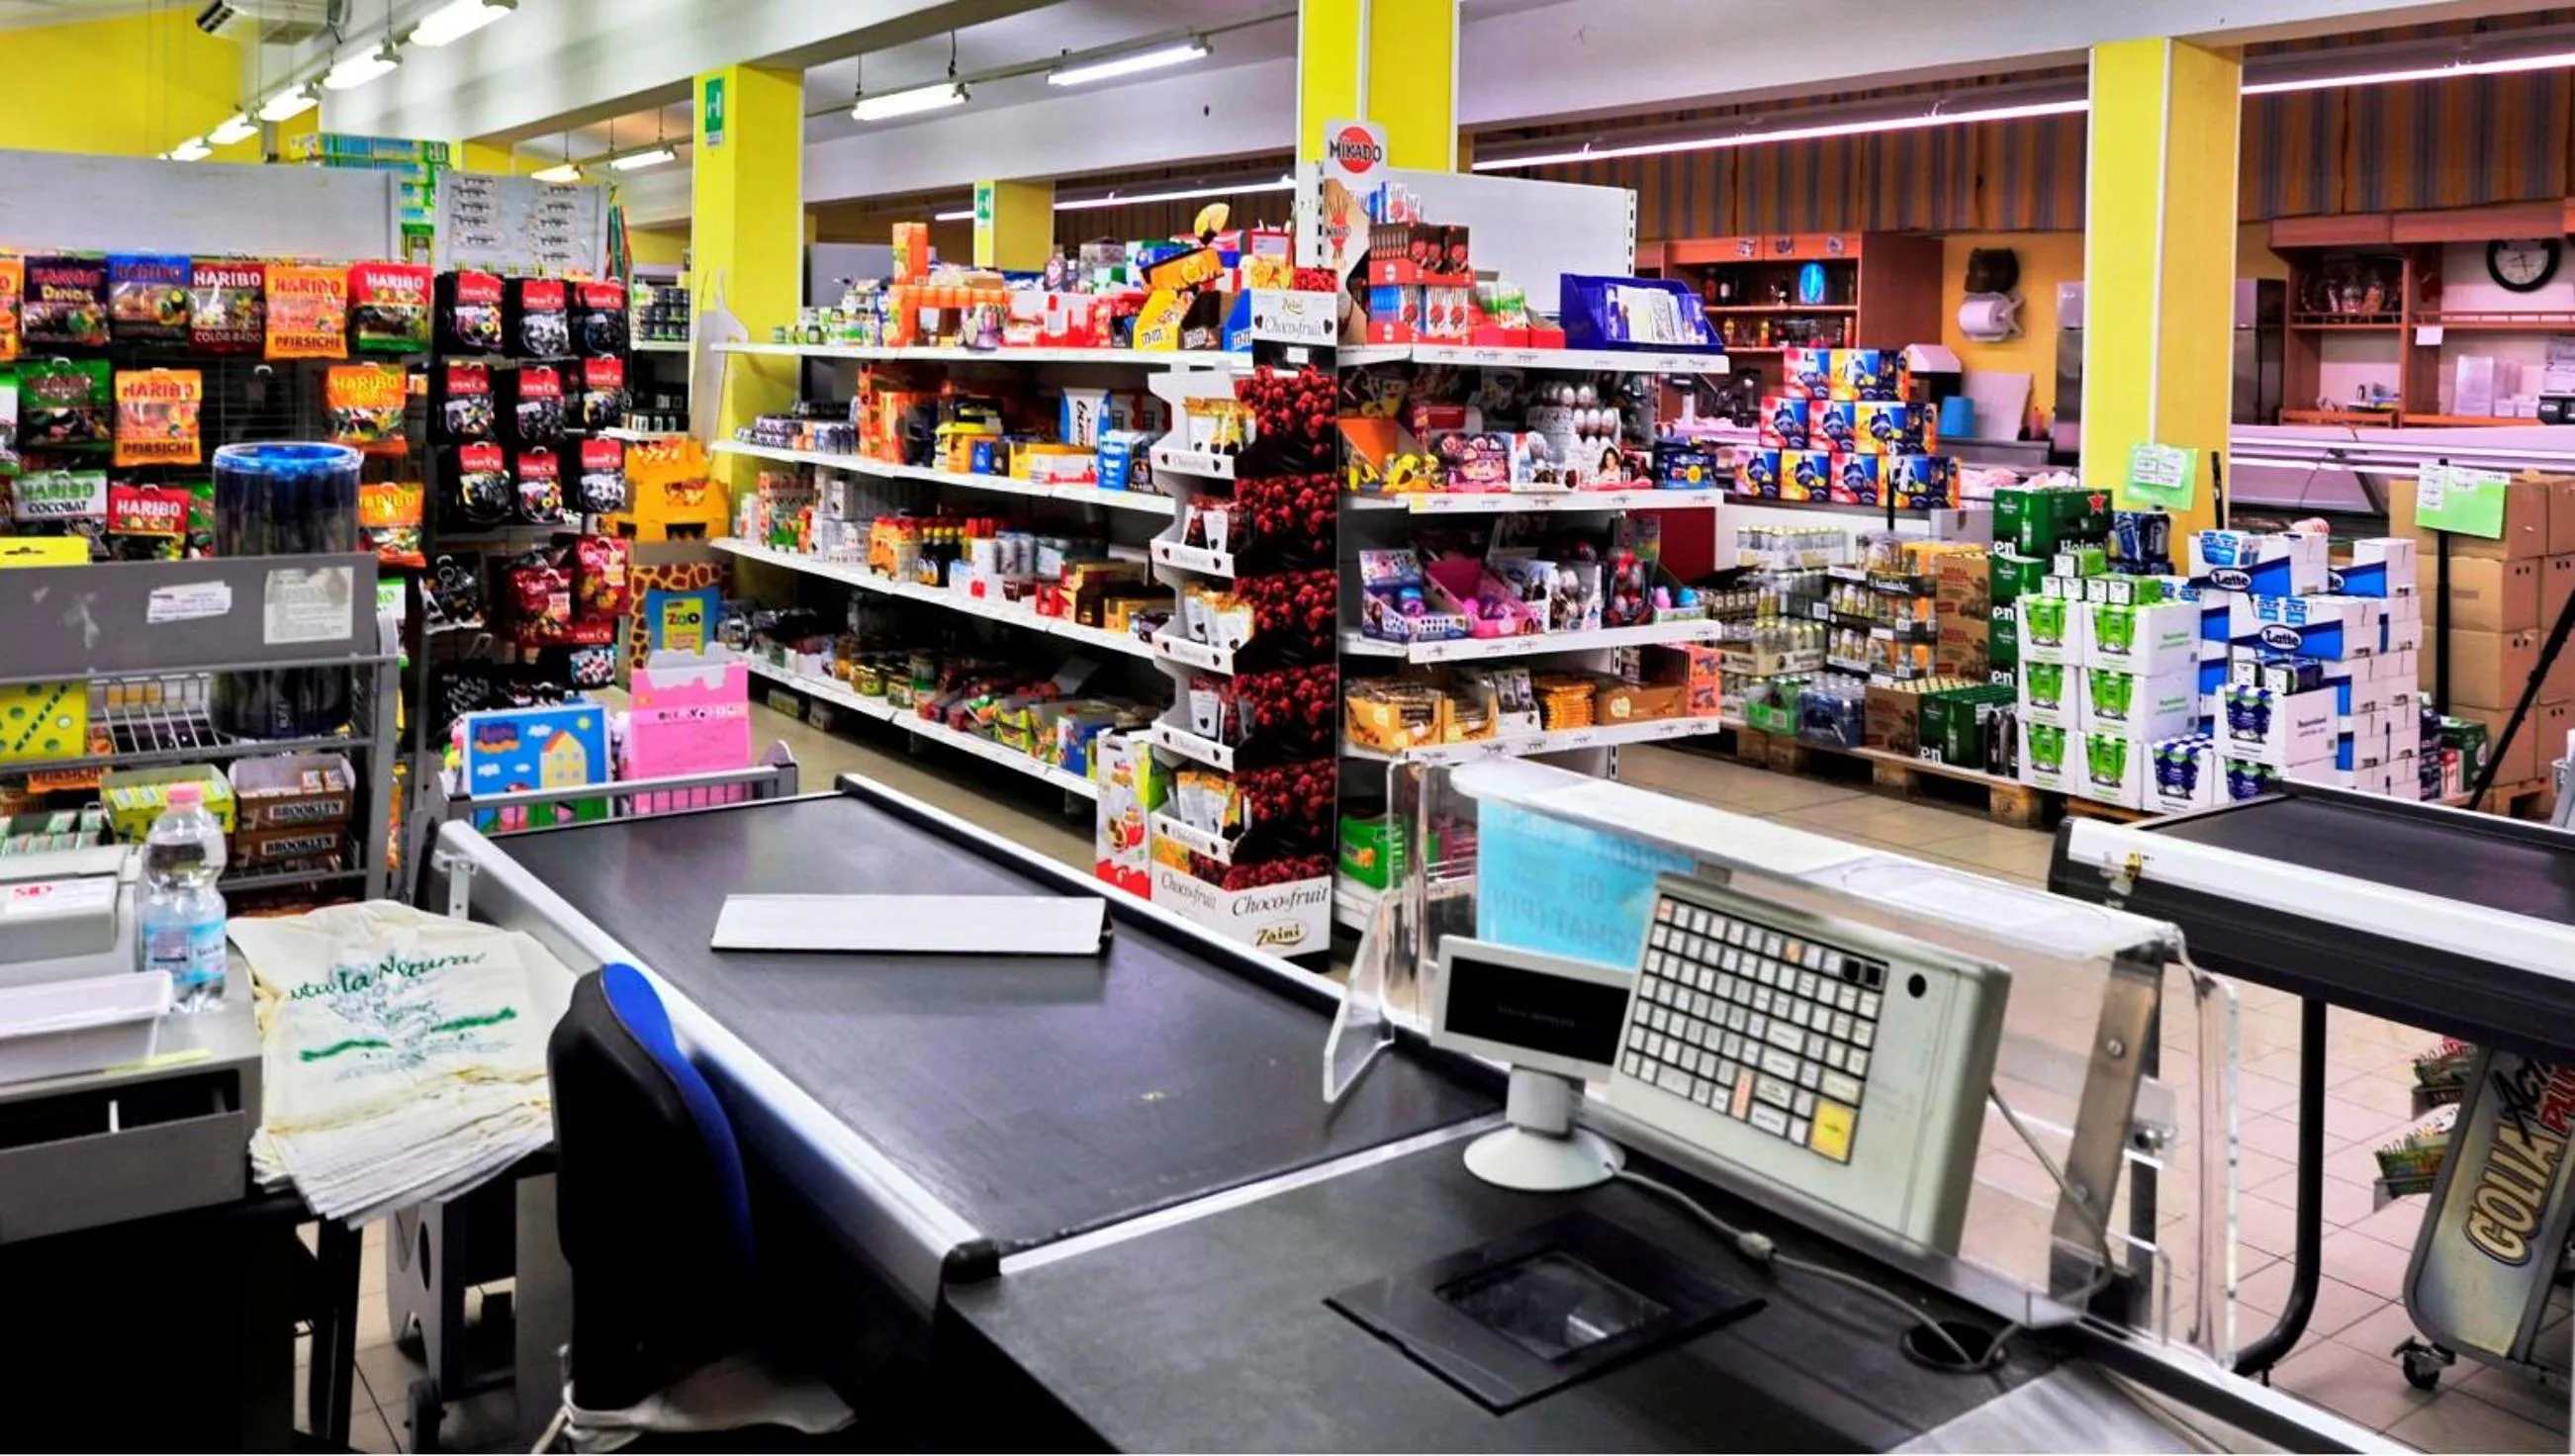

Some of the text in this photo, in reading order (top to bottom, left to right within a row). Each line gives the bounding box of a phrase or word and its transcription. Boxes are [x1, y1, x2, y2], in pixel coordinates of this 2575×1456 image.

[1330, 139, 1382, 163] MIKADO
[194, 271, 261, 287] HARIBO
[275, 278, 340, 295] HARIBO
[367, 272, 424, 290] HARIBO
[123, 382, 195, 397] HARIBO
[117, 500, 180, 515] HARIBO
[2215, 572, 2249, 586] Latte
[2265, 629, 2299, 646] Latte
[273, 801, 341, 818] BROOKLYN
[264, 837, 332, 854] BROOKLYN
[1255, 923, 1301, 947] Zaini
